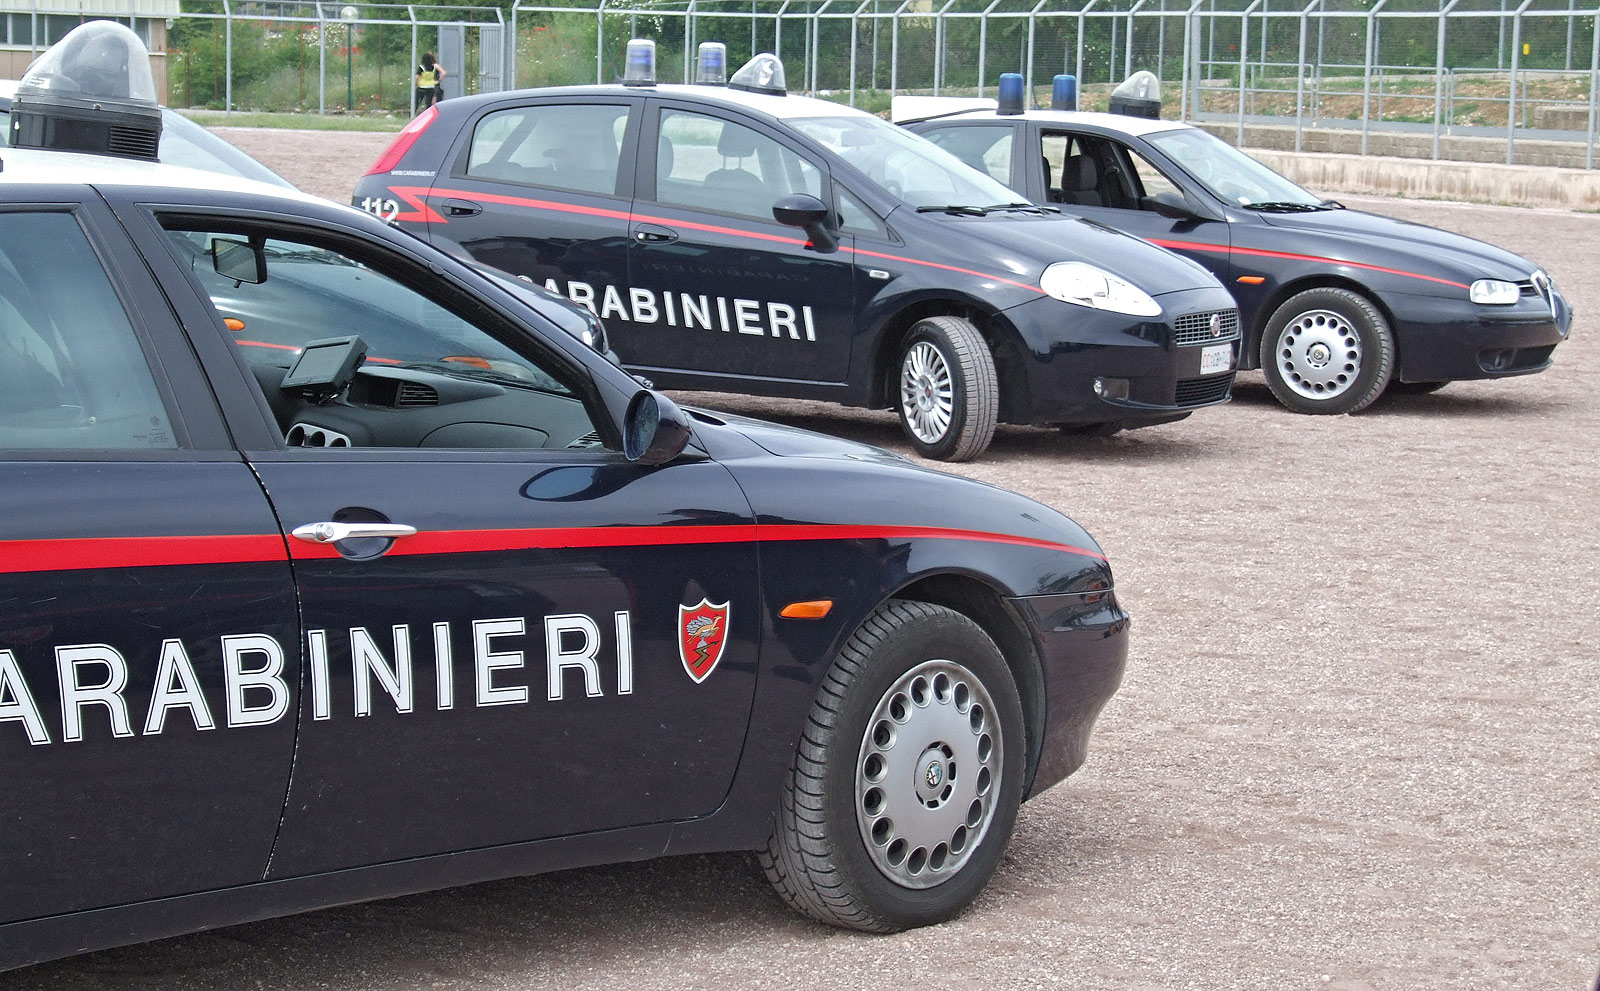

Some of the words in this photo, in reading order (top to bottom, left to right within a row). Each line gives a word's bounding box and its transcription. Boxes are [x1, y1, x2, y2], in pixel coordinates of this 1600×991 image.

[361, 197, 399, 225] 112
[517, 275, 816, 342] RABINIERI
[0, 611, 635, 746] ARABINIERI
